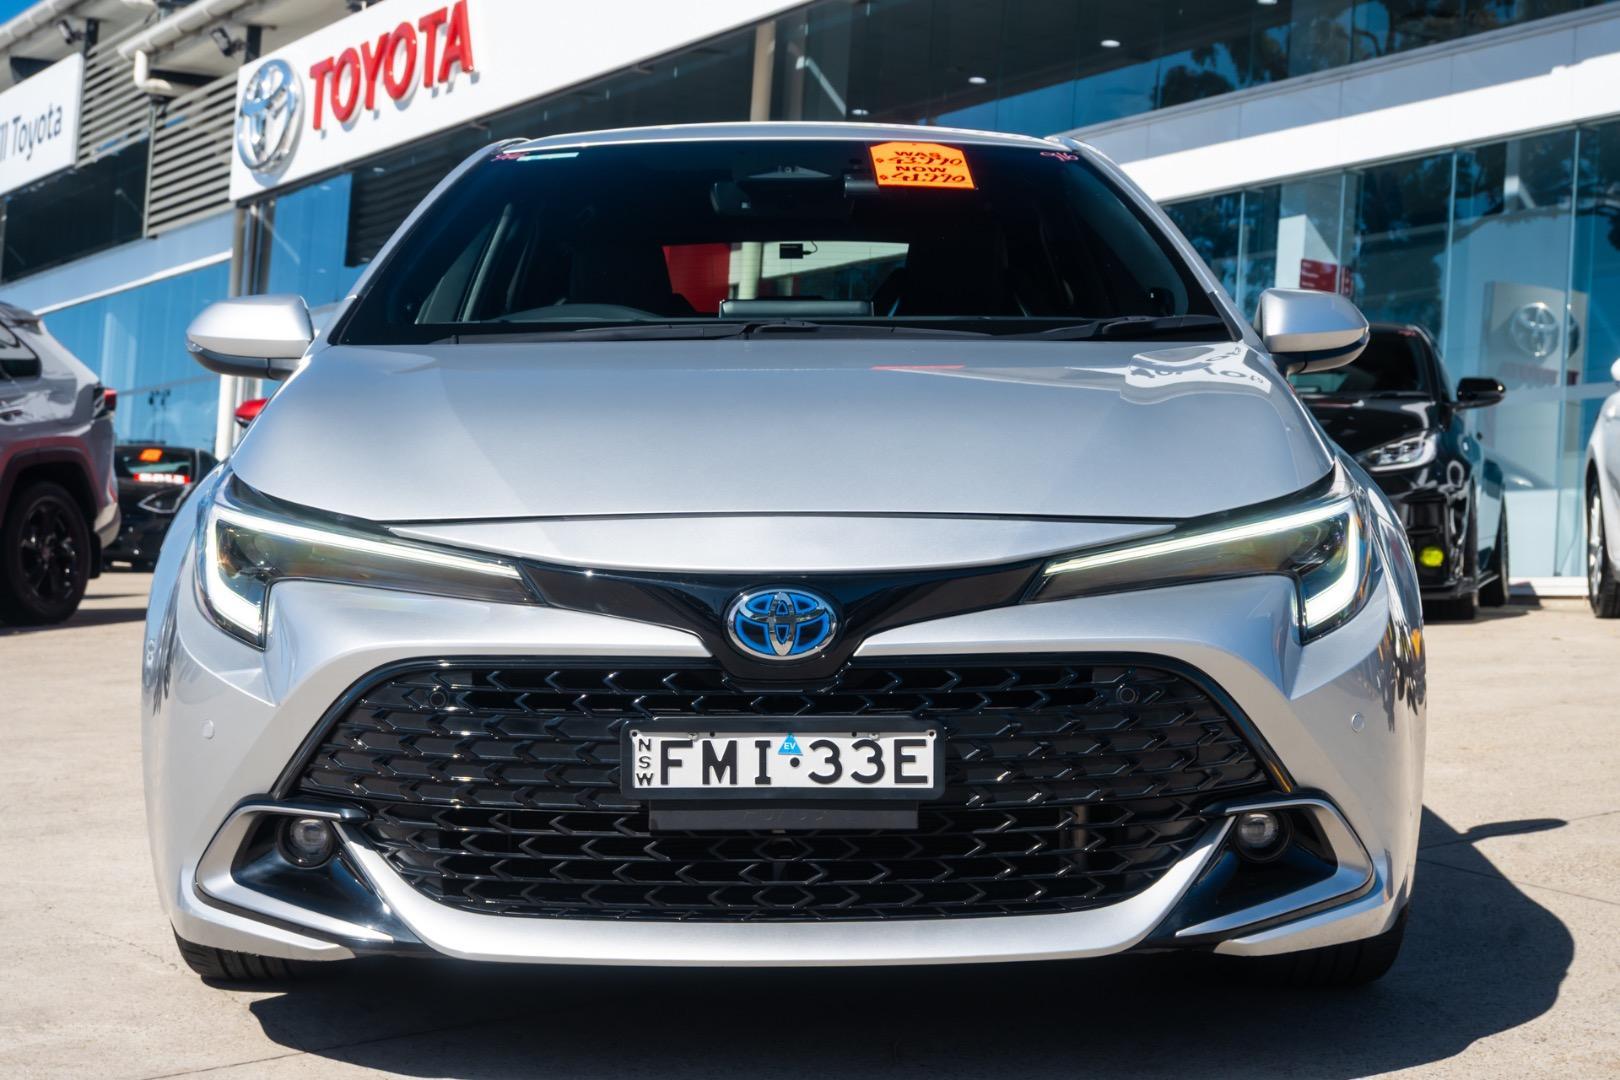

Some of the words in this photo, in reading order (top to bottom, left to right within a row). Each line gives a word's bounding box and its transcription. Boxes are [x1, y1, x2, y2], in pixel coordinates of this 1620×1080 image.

[309, 0, 474, 130] TOYOTA
[12, 102, 62, 161] Toyota
[895, 165, 947, 173] NOW
[636, 738, 654, 786] NSW
[783, 742, 796, 750] EV
